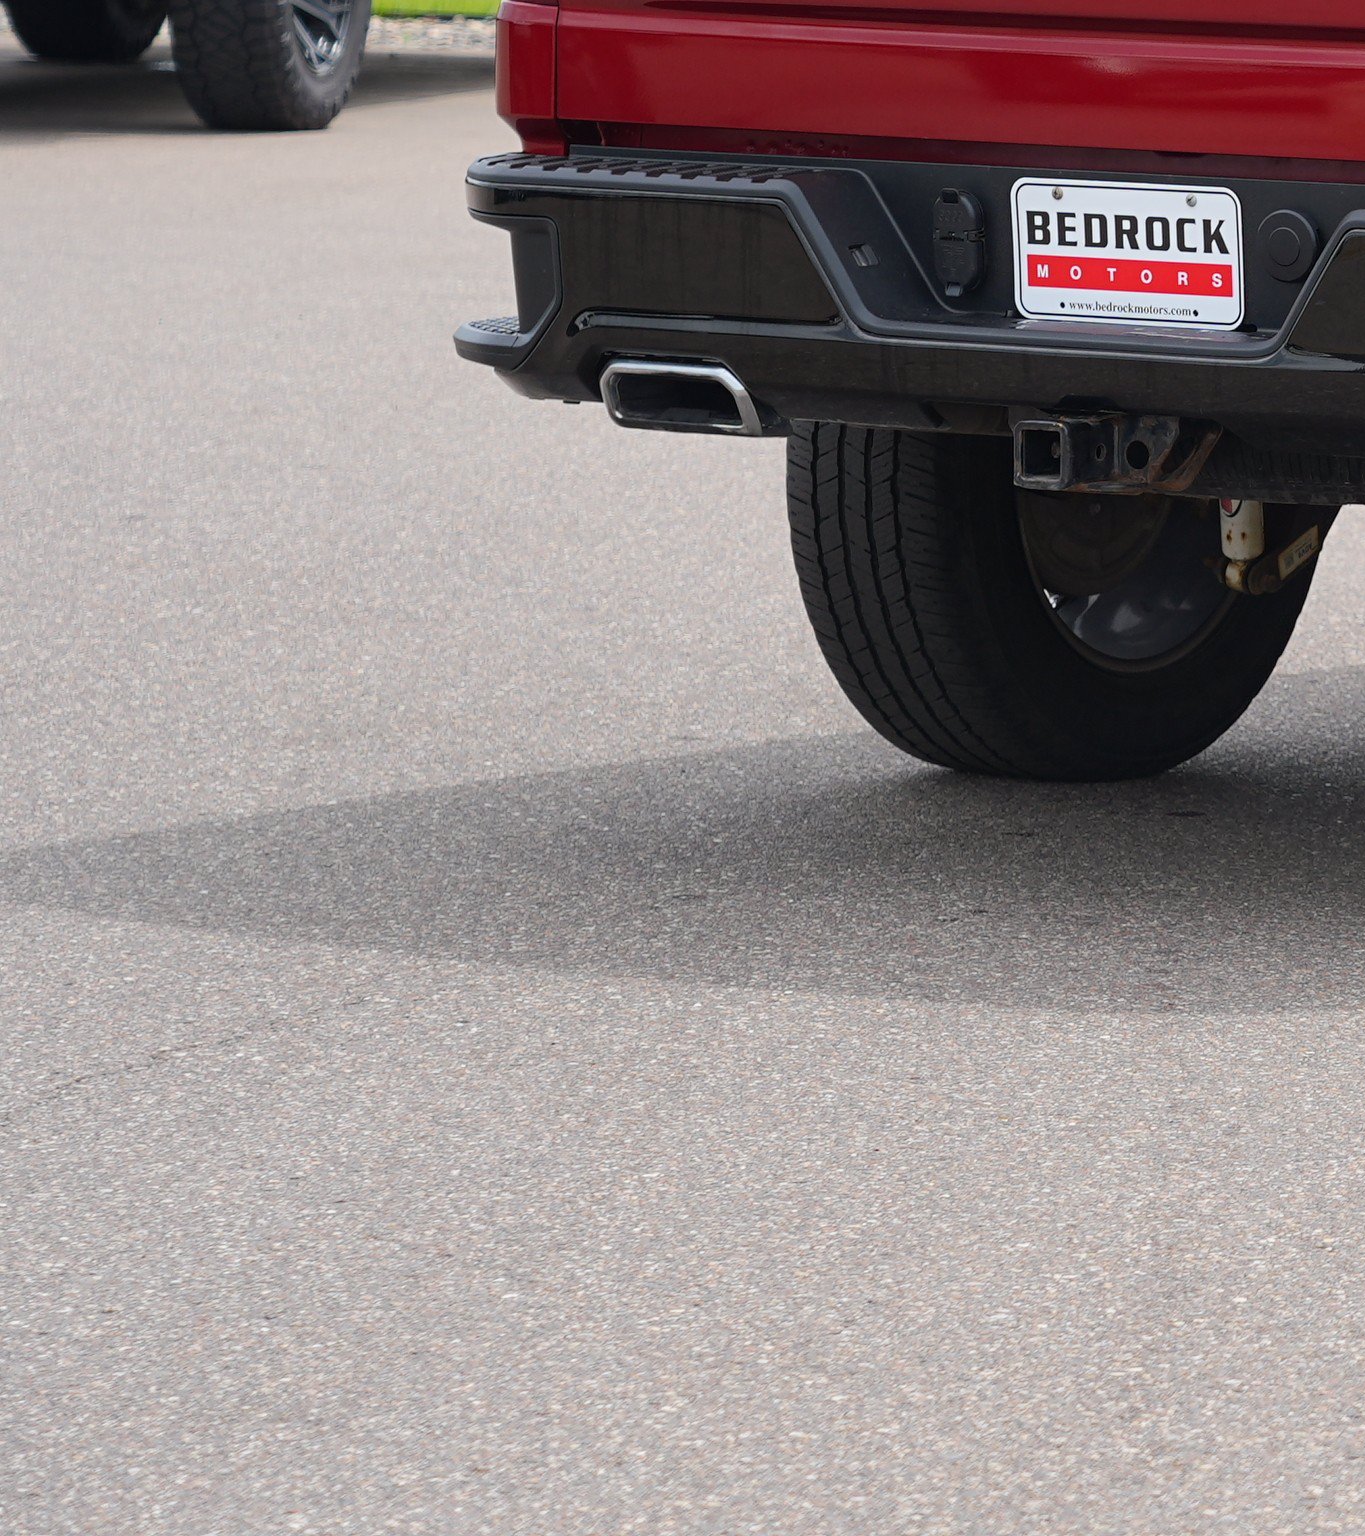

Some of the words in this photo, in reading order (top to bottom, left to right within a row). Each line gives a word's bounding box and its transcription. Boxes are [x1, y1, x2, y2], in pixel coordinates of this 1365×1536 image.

[1025, 210, 1231, 254] BEDROCK
[1036, 263, 1224, 289] MOTORS
[1069, 300, 1192, 317] www.bedrockmotors.com
